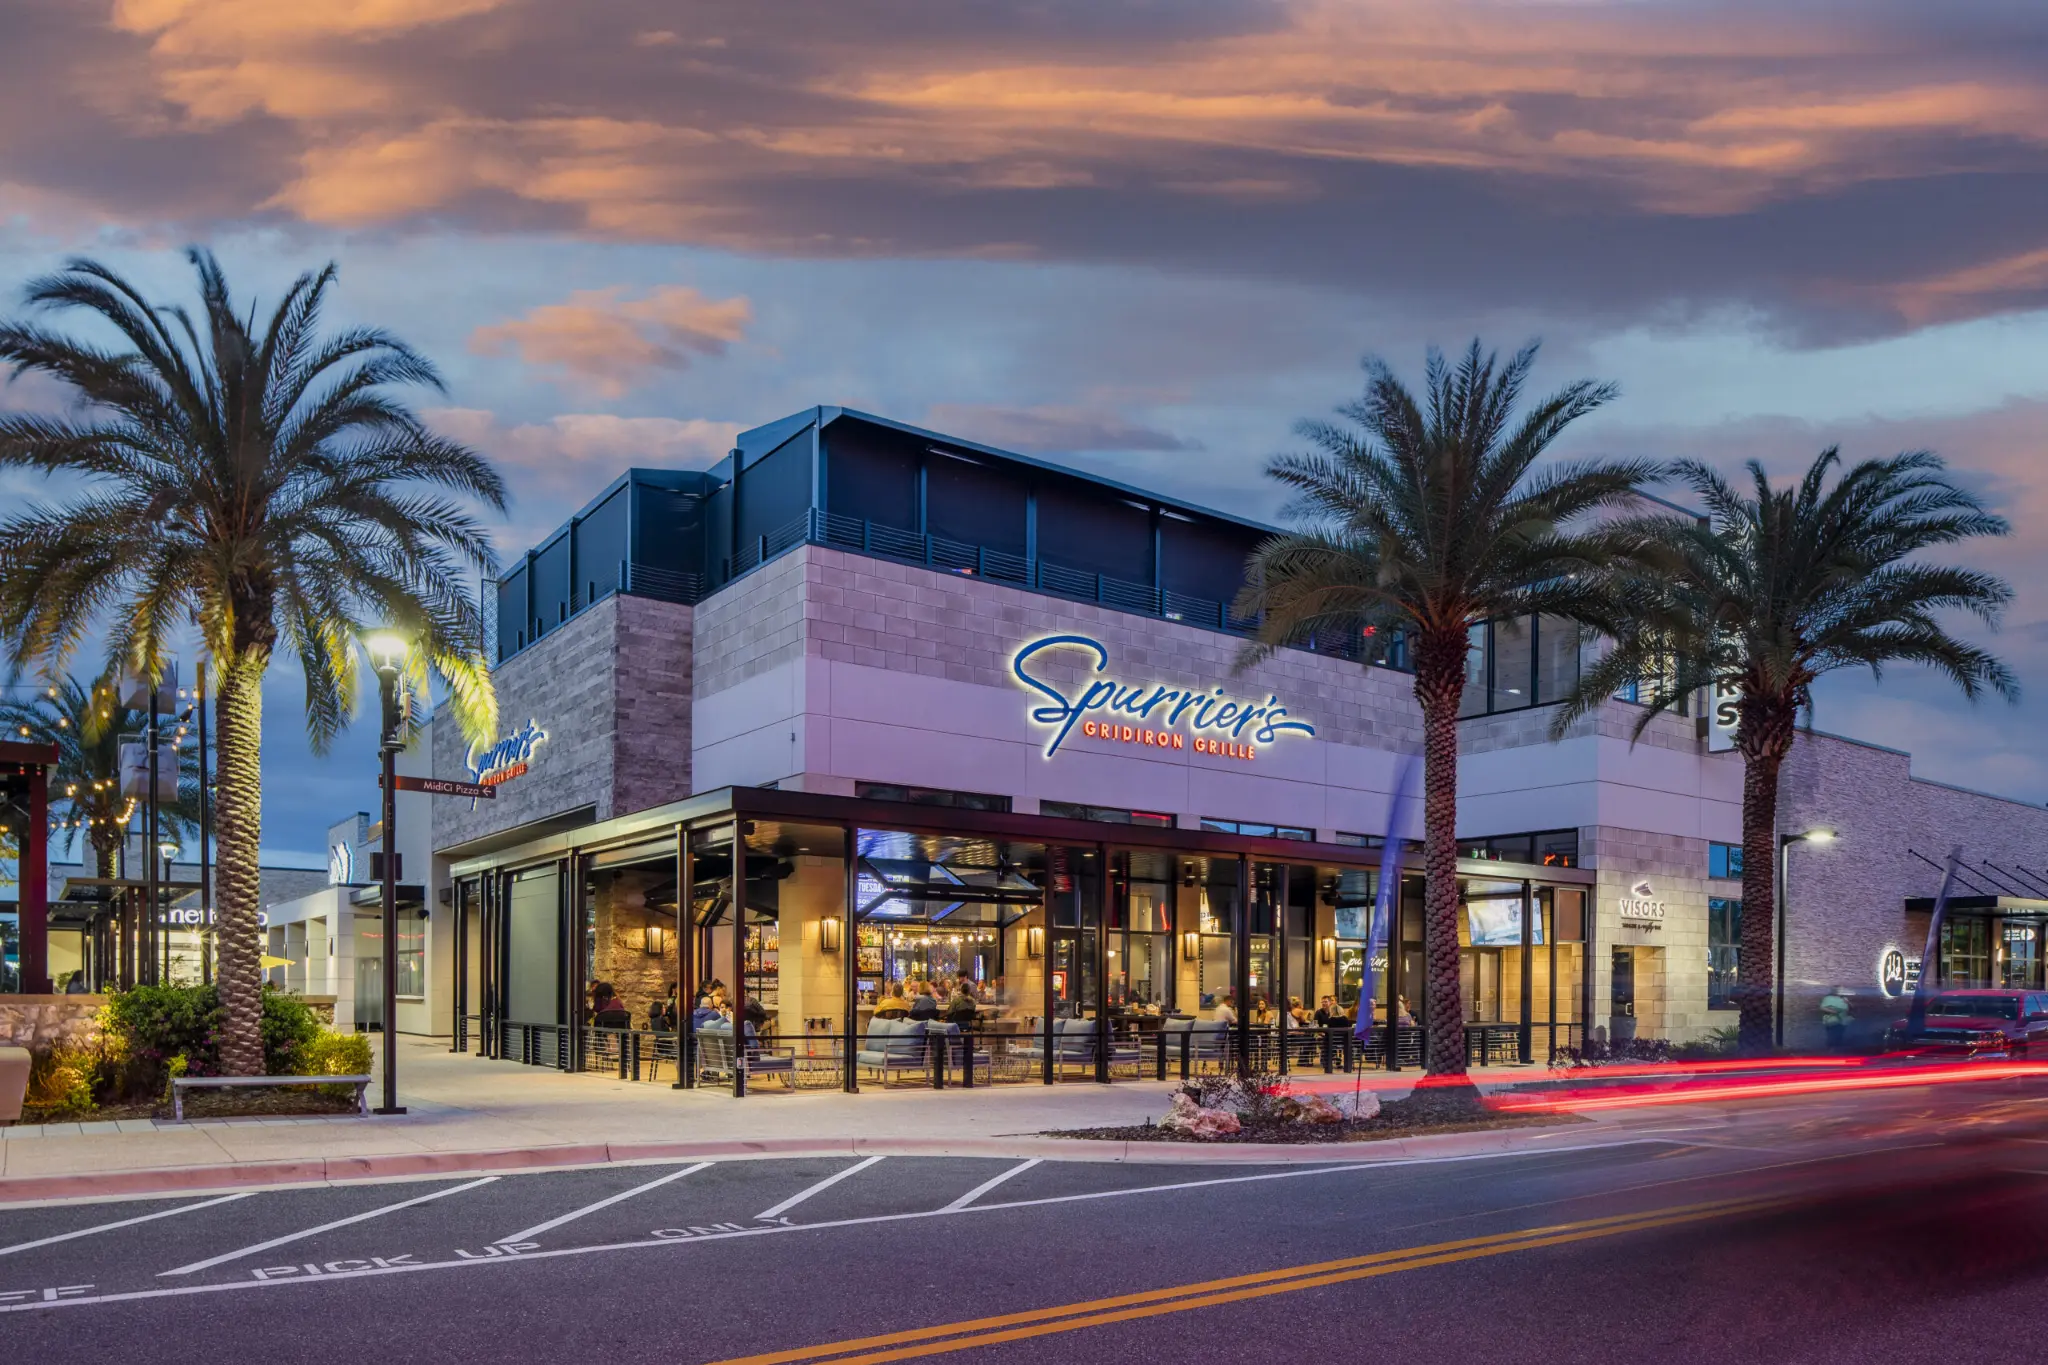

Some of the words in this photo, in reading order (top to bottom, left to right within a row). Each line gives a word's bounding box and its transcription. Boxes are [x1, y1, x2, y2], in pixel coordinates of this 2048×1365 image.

[1013, 635, 1316, 758] Spurrier's
[1084, 720, 1184, 750] GRIDIRON
[1193, 737, 1256, 761] GRILLE
[423, 781, 453, 792] MidiCi
[456, 784, 479, 795] Pizza
[1621, 899, 1665, 917] VISORS
[252, 1253, 423, 1280] PICK
[454, 1242, 541, 1259] UP
[650, 1216, 796, 1238] ONLY
